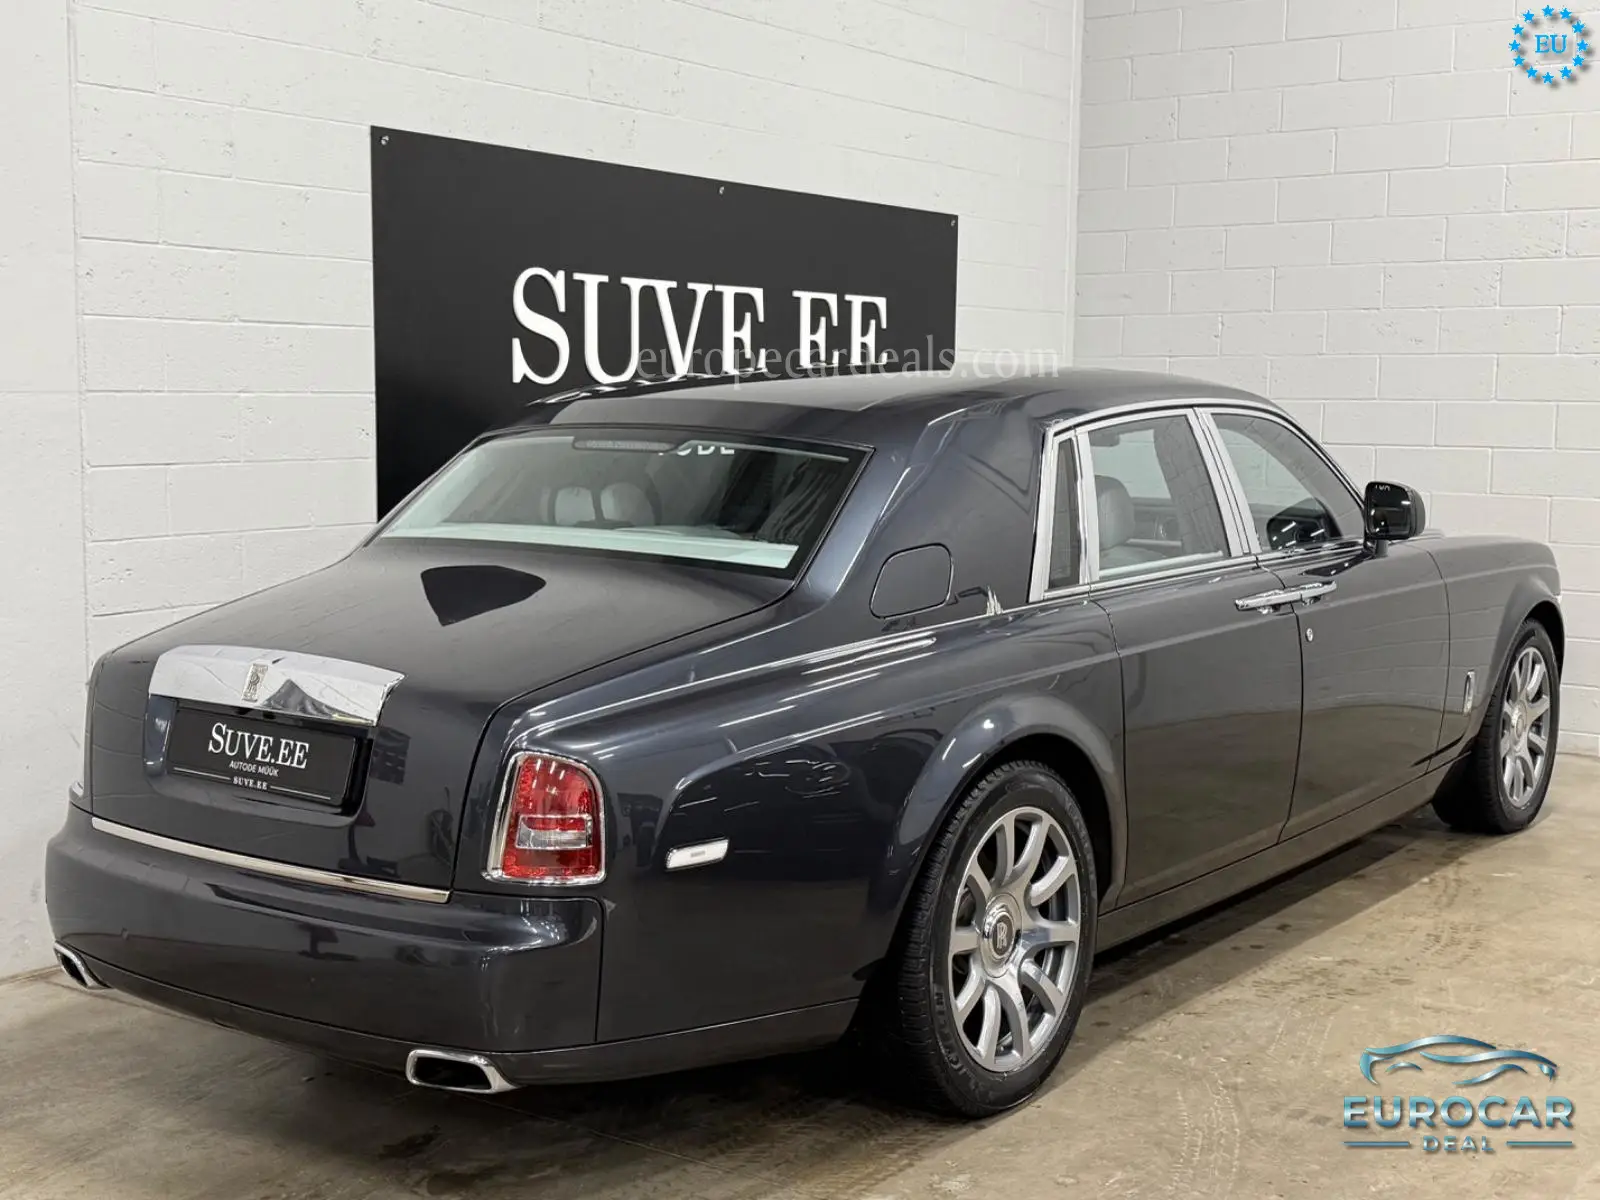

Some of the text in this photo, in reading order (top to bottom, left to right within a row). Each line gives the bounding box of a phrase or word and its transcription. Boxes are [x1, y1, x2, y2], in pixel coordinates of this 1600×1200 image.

[511, 266, 888, 385] SUVEEE
[208, 722, 310, 769] SUVE.EE
[229, 760, 257, 773] AUTODE
[233, 776, 268, 790] SUVE.EE
